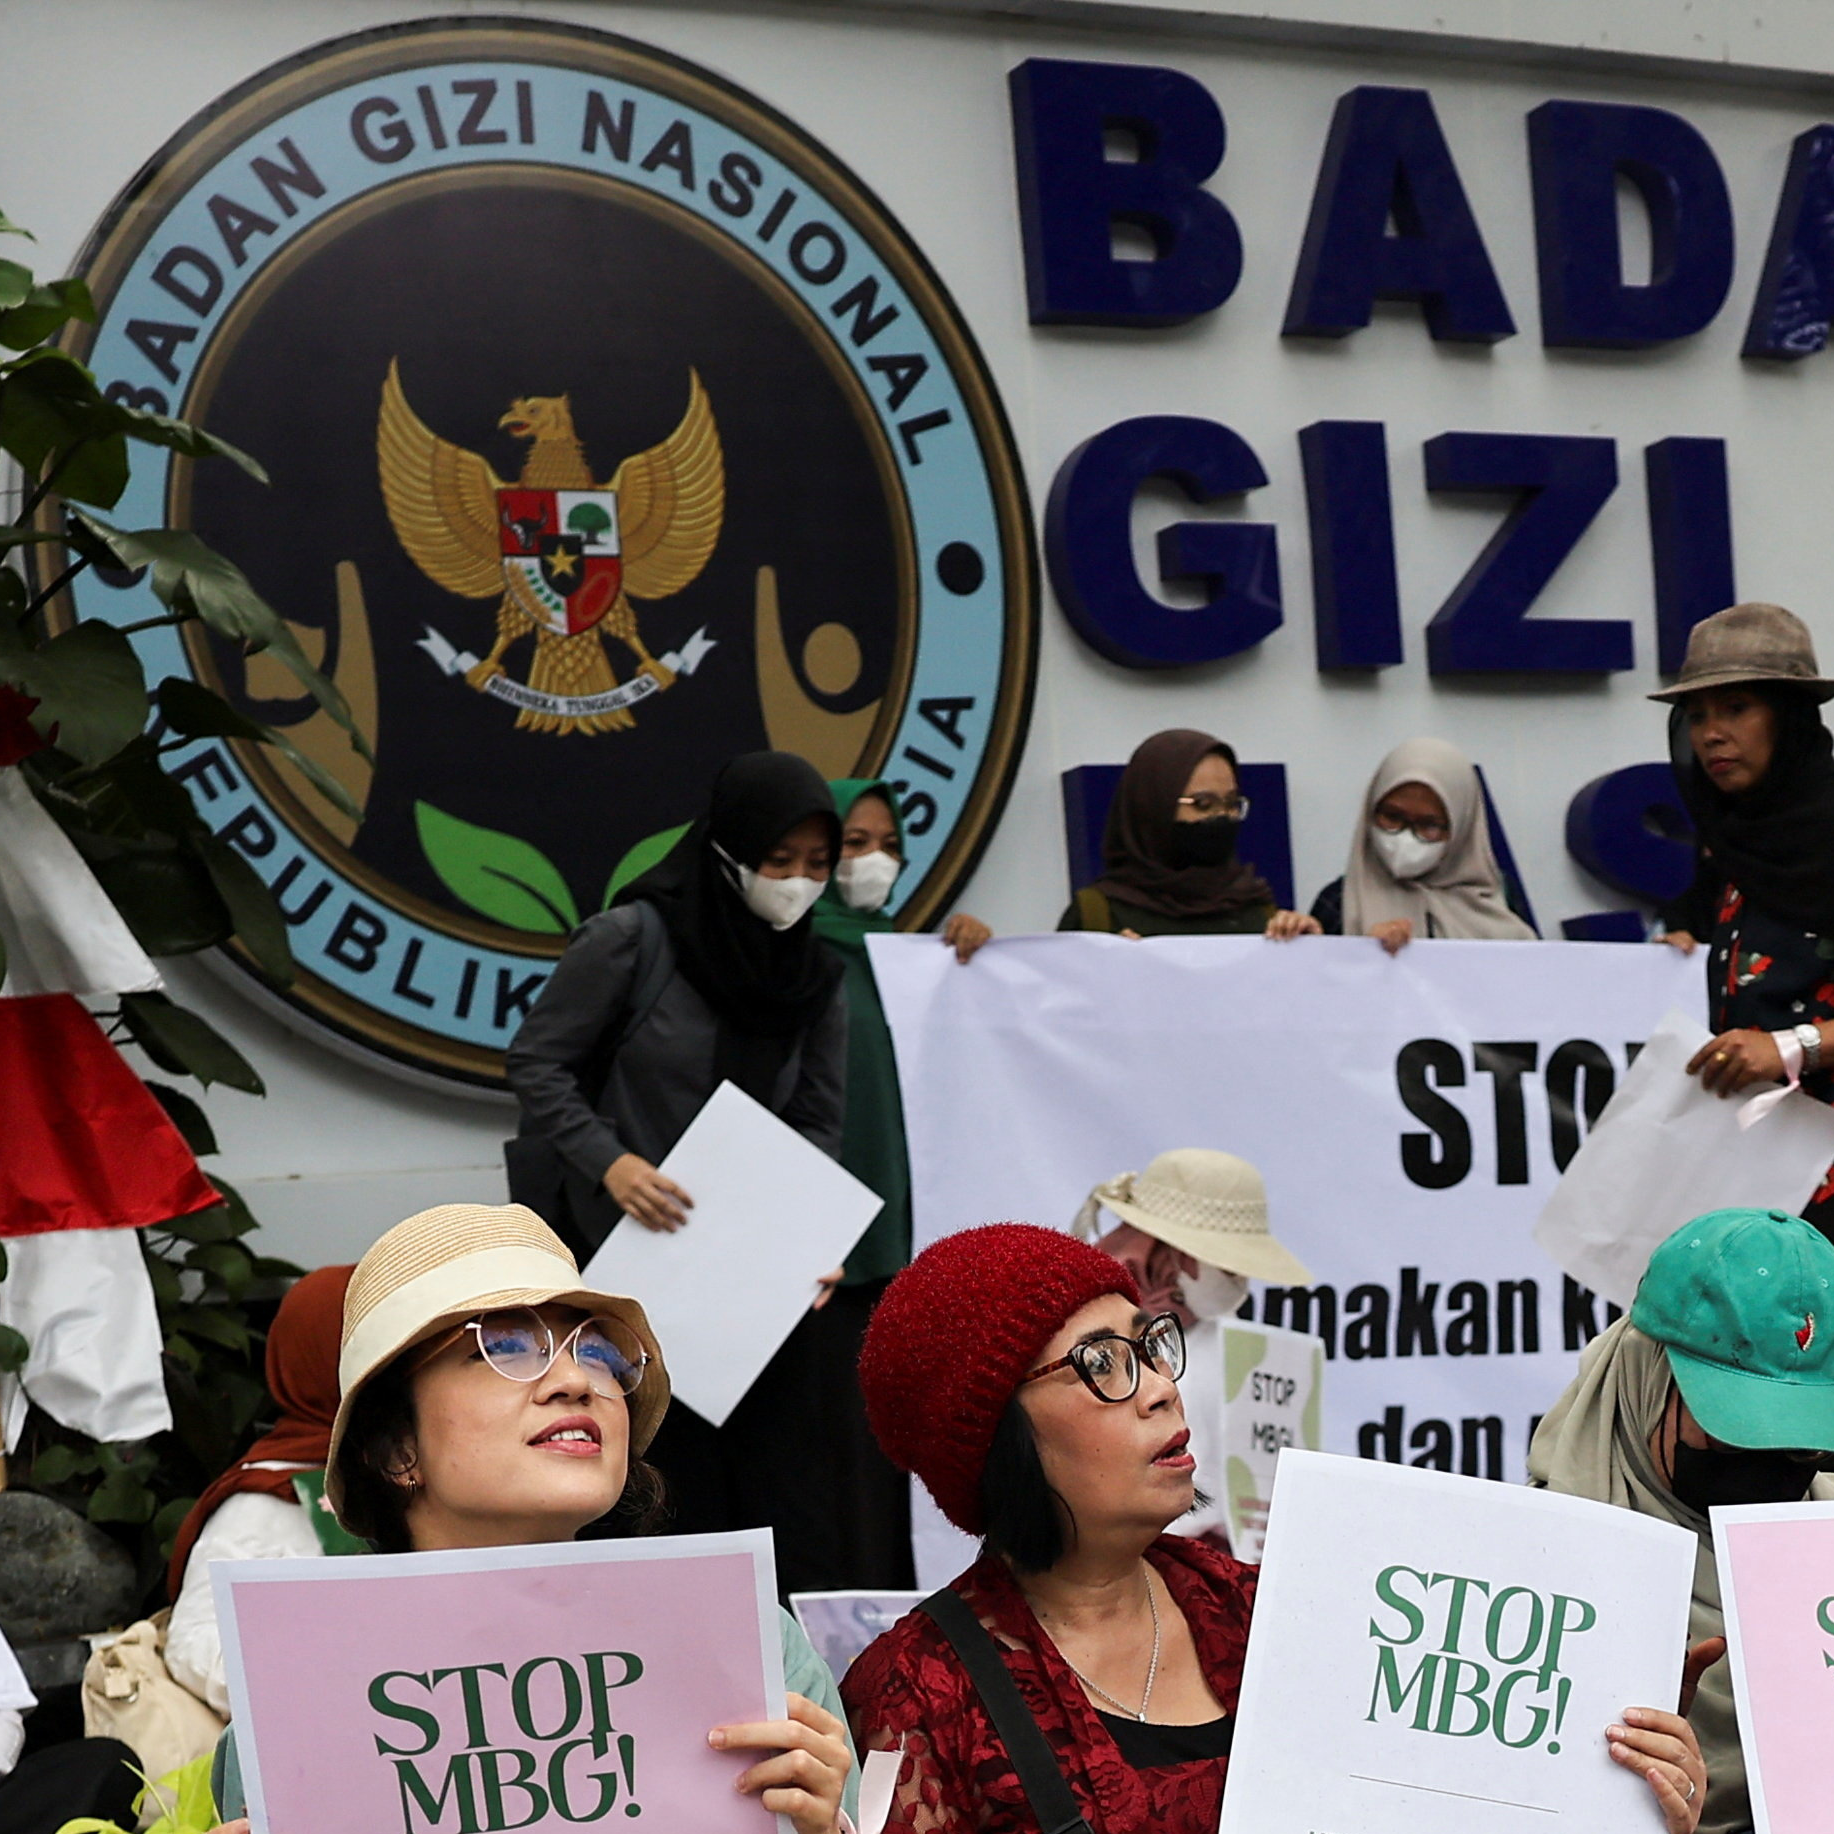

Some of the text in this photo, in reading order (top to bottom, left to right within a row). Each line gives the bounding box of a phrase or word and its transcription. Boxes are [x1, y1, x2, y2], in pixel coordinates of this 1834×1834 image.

[350, 78, 536, 164] GIZI
[581, 90, 953, 467] NASIONAL
[1045, 414, 1736, 677] GIZI
[147, 688, 548, 1030] EPUBLIK
[1396, 1038, 1646, 1190] STO
[1252, 1371, 1296, 1405] STOP
[1358, 1405, 1505, 1482] dan
[1369, 1565, 1597, 1673] STOP
[368, 1651, 644, 1757] STOP
[1364, 1643, 1572, 1755] MBG!
